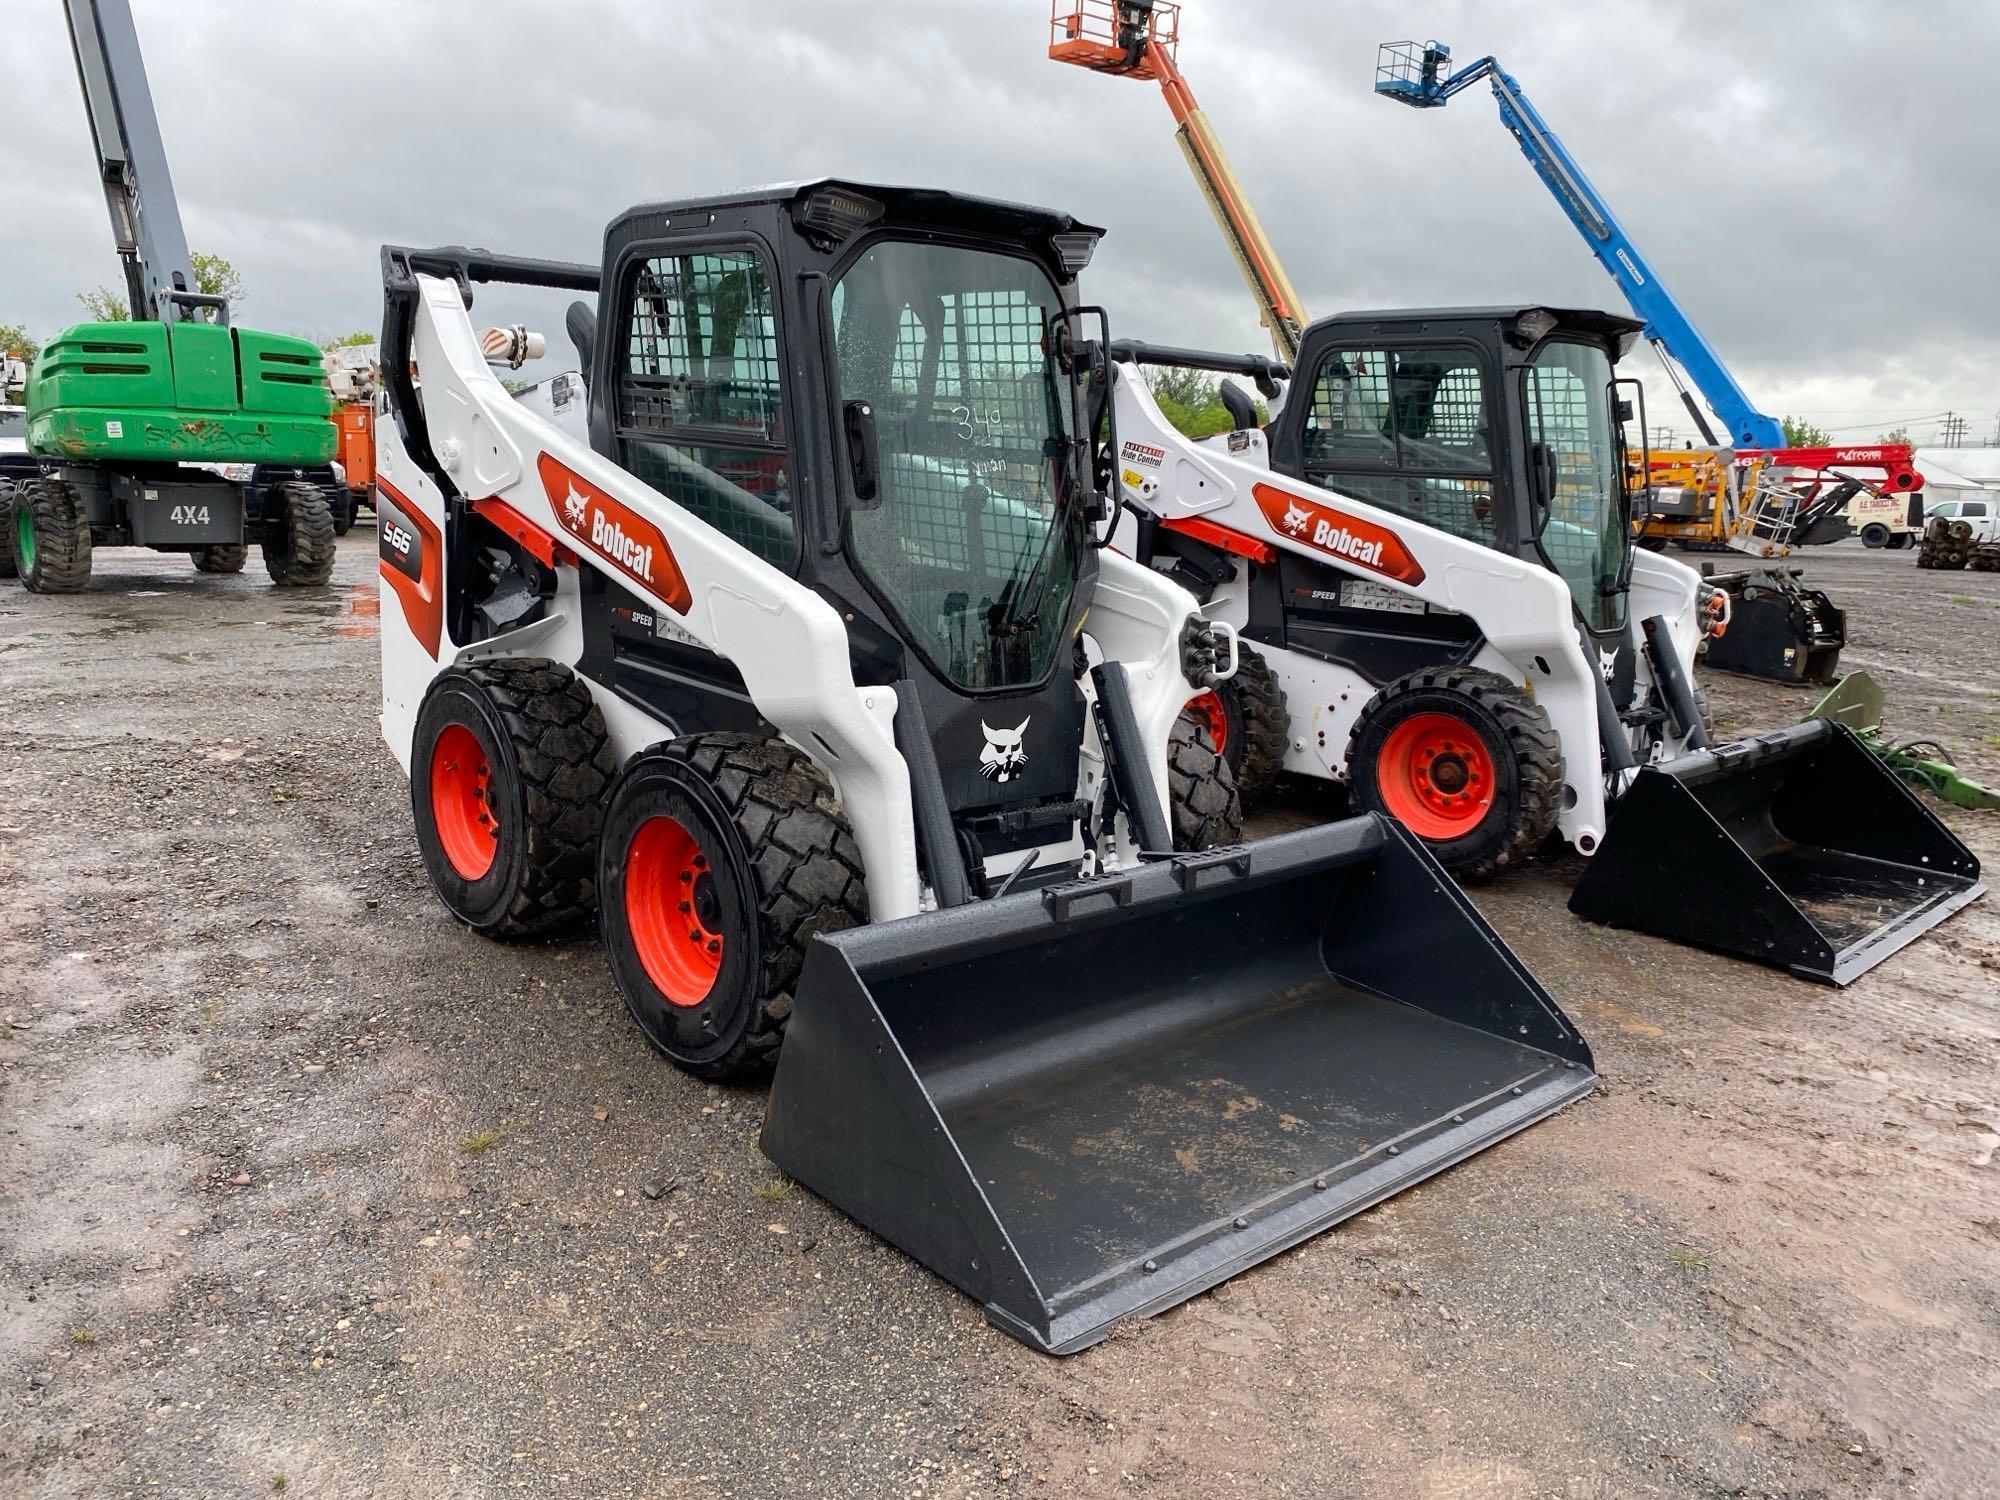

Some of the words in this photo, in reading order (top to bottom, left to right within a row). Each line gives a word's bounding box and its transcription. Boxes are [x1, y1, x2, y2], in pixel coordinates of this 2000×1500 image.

[1121, 449, 1136, 460] Ride
[1137, 453, 1162, 467] Control
[1125, 442, 1165, 458] AUTOMATIC
[170, 505, 210, 525] 4X4
[383, 520, 412, 555] S66
[591, 507, 653, 581] Bobcat
[1312, 518, 1383, 566] Bobcat
[1311, 590, 1336, 600] SPEED
[631, 611, 653, 627] SPEED
